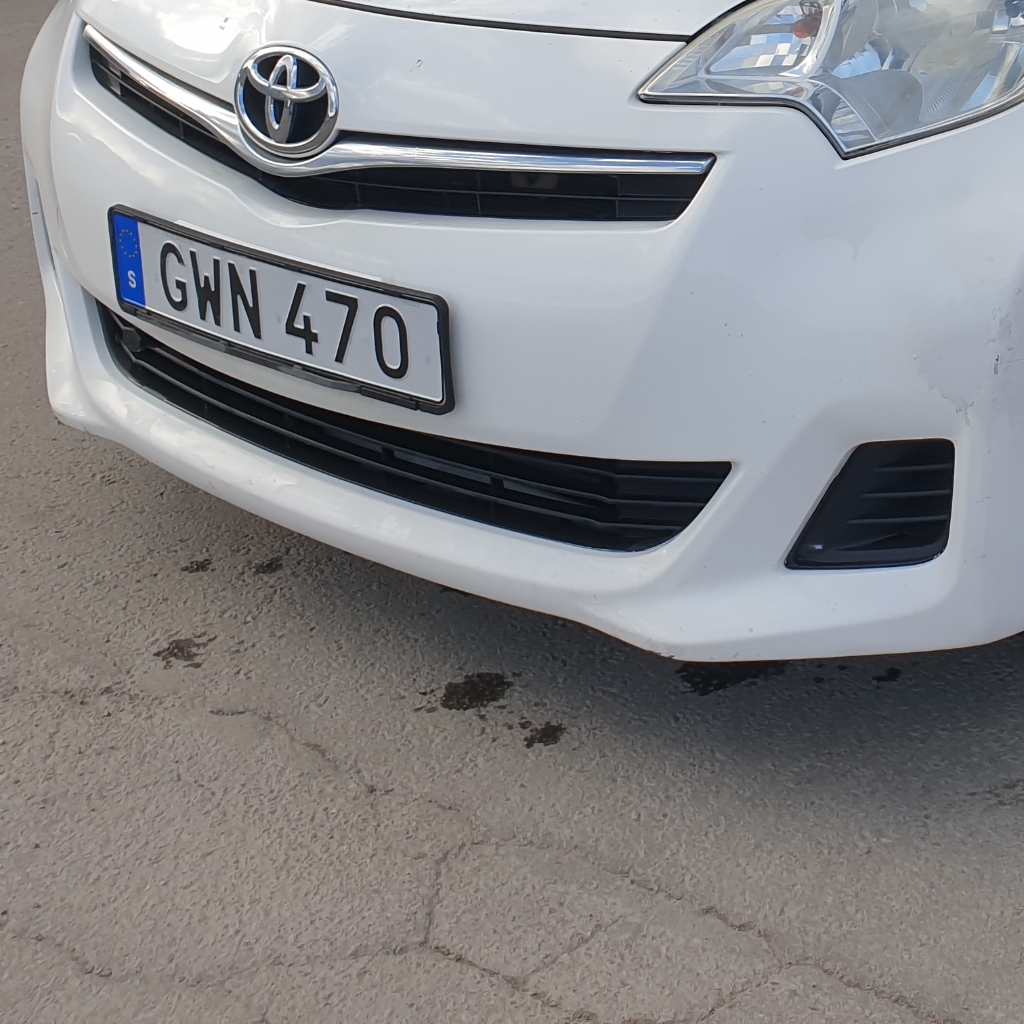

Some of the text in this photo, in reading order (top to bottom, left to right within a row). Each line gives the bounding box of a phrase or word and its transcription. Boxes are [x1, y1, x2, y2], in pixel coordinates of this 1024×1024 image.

[127, 269, 137, 289] S
[159, 241, 409, 379] GWN 470
